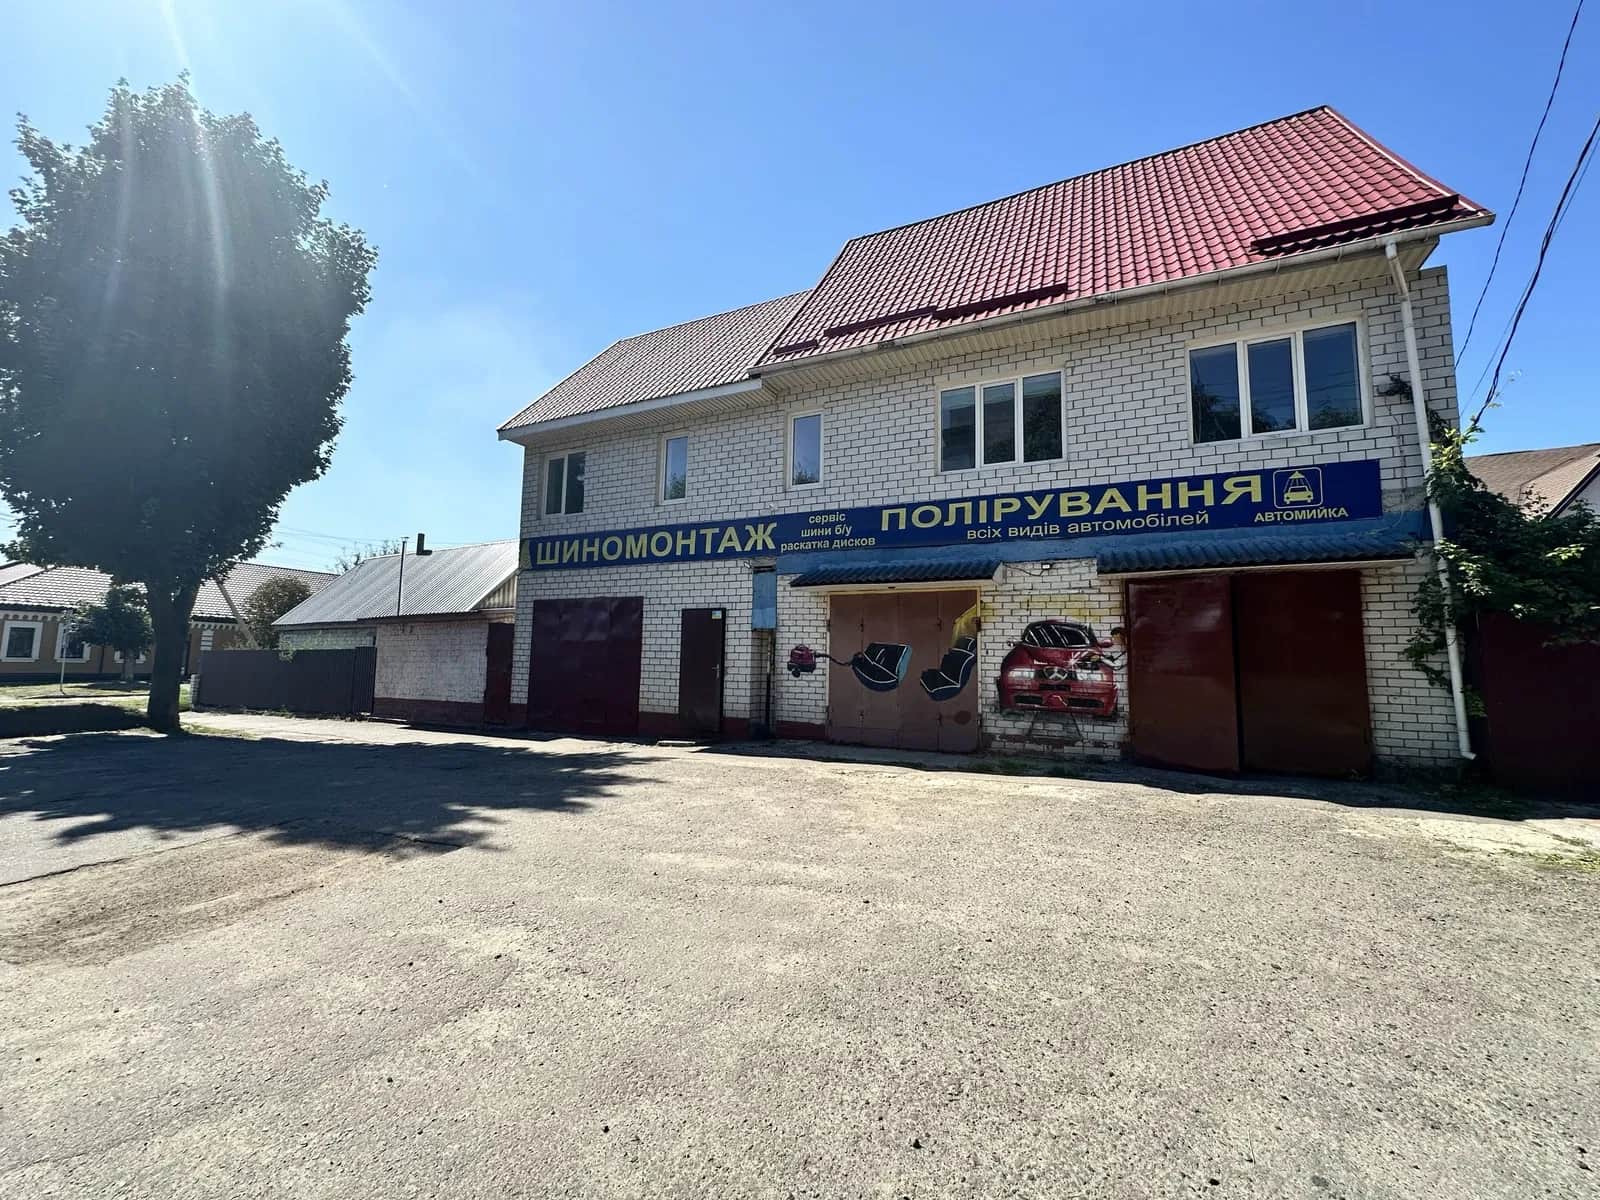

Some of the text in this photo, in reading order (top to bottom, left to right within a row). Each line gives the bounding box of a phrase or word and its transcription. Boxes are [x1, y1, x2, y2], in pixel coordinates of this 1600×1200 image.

[881, 475, 1262, 531] ПОЛІРУВАННЯ
[808, 511, 846, 525] сервіс
[1254, 507, 1349, 523] АВТОМИЙКА
[801, 524, 852, 537] шини б/у
[967, 510, 1209, 540] всіх видів автомобілей
[536, 522, 777, 565] ШИНОМОНТАЖ
[780, 537, 876, 553] раскатка дисков
